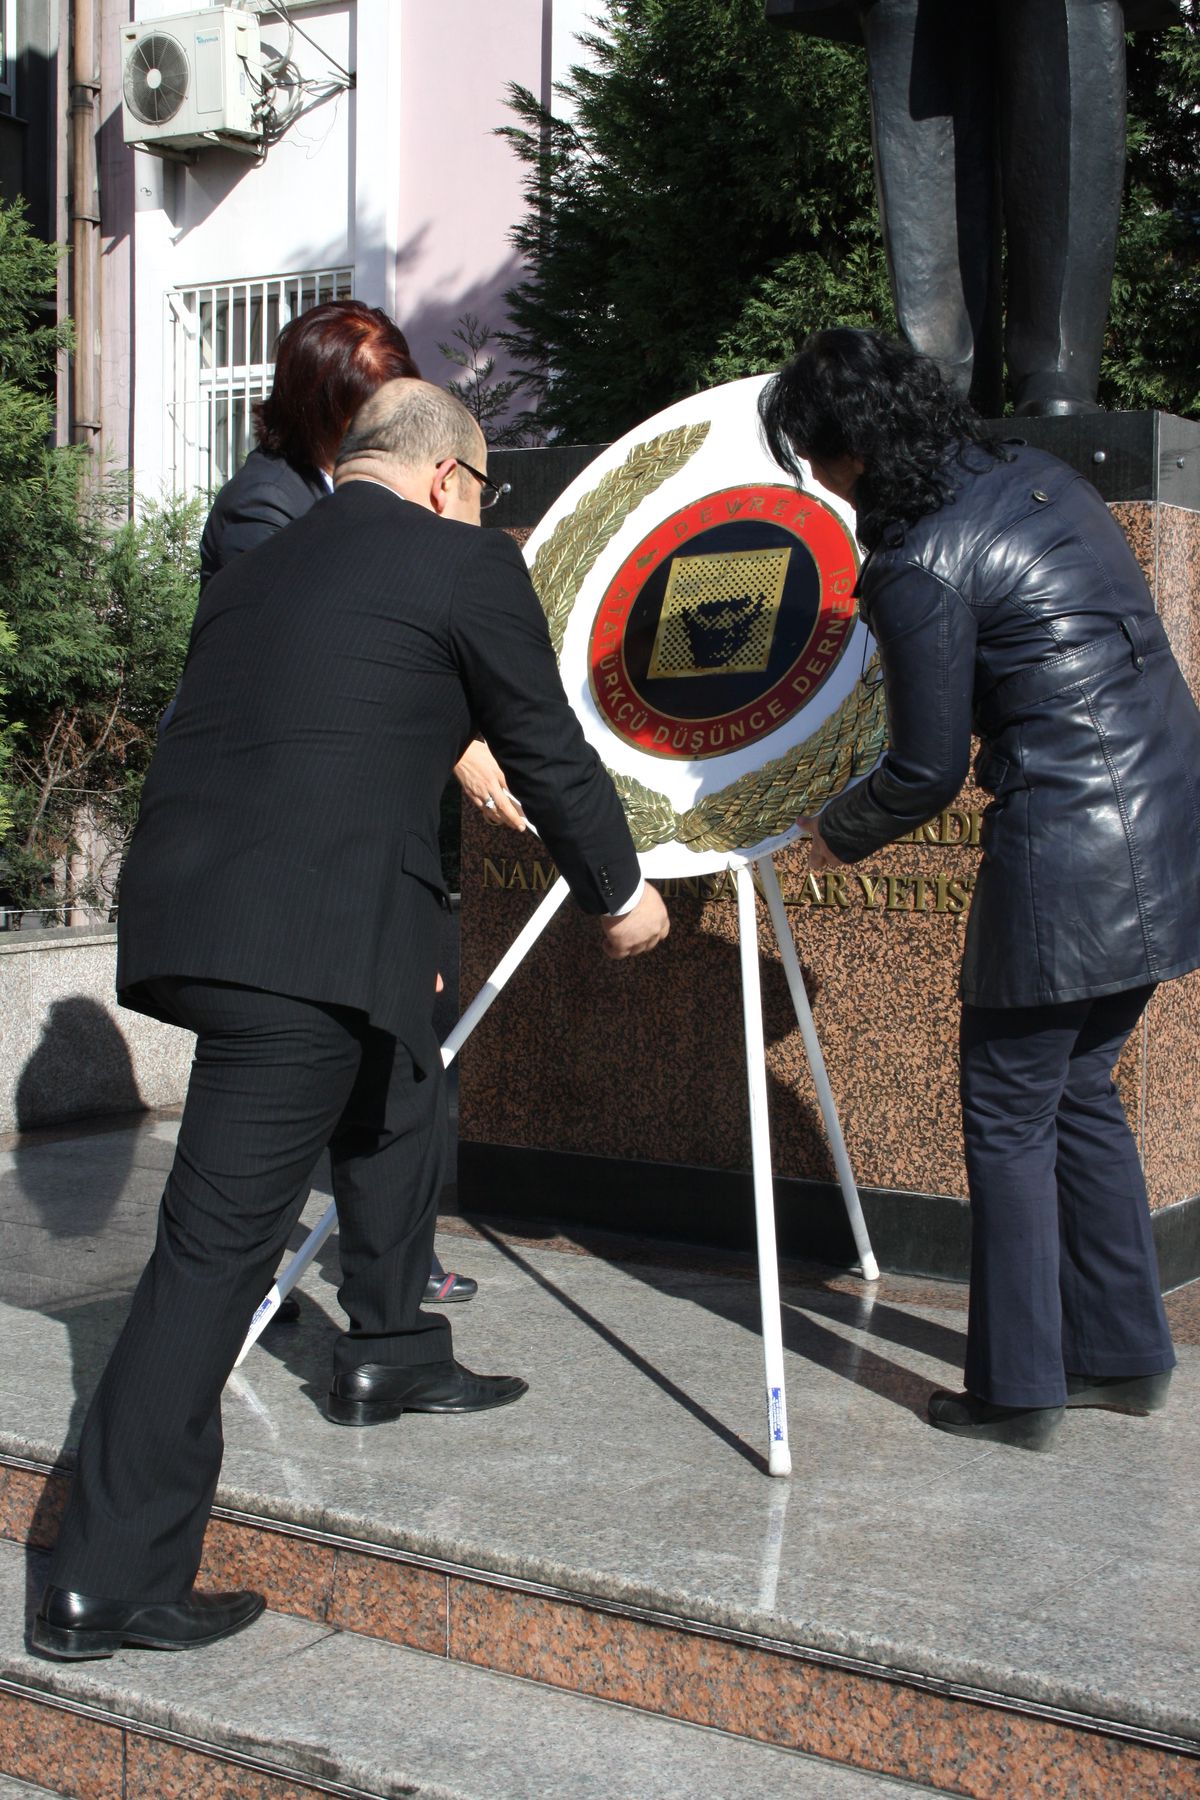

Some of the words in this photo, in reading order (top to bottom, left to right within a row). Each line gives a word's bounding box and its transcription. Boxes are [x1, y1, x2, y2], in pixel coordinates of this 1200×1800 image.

[674, 495, 813, 539] DEVREK
[598, 586, 648, 730] ATATÜRKÇÜ
[652, 697, 786, 752] DÜŞÜNCE
[791, 566, 853, 697] DERNEĞİ
